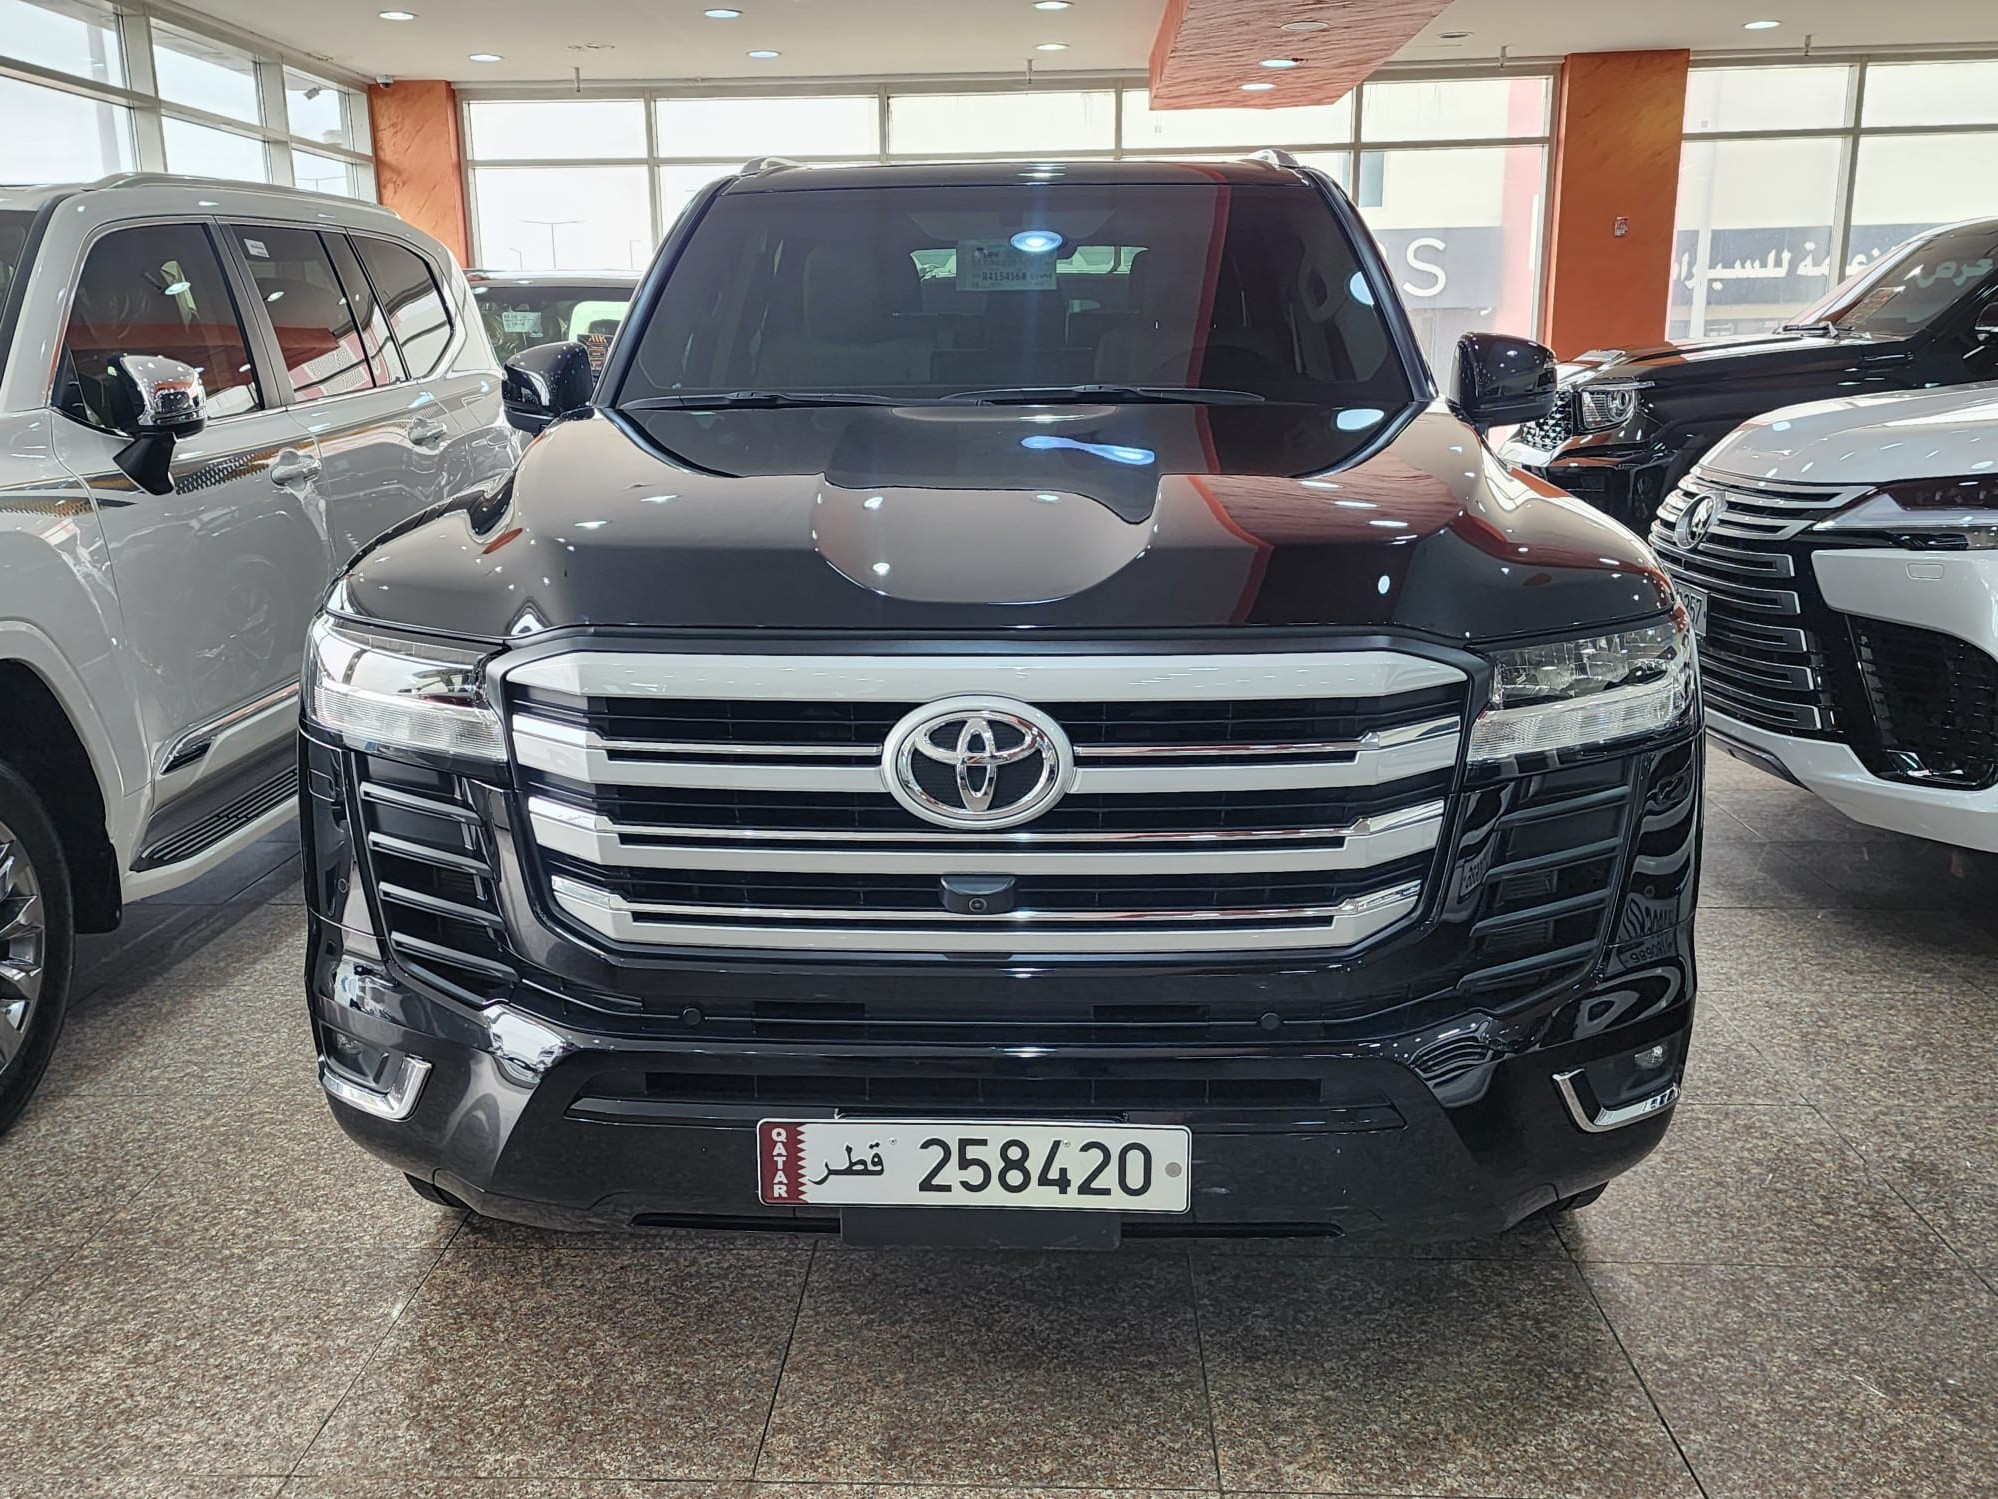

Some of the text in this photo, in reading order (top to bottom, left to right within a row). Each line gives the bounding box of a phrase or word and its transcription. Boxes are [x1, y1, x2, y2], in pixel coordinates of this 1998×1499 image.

[770, 1127, 789, 1198] QATAR
[808, 1142, 885, 1185] قطر
[918, 1138, 1152, 1196] 258420
